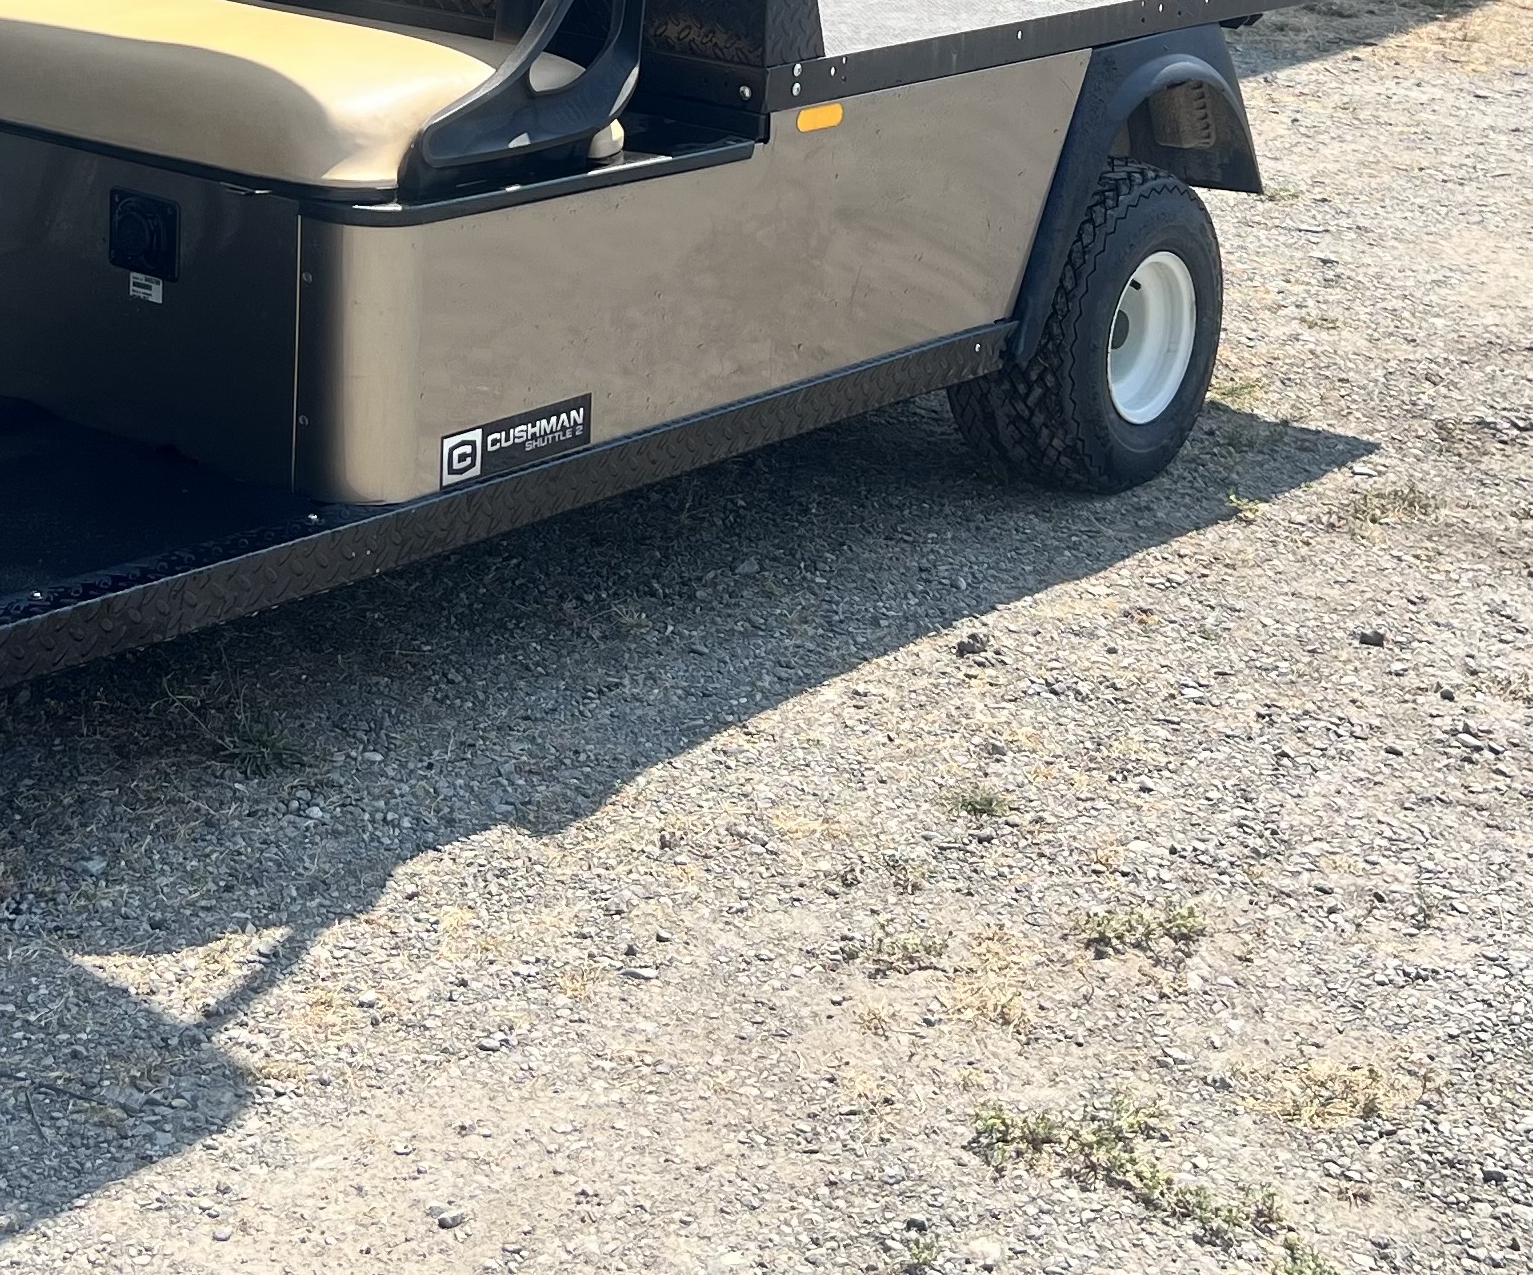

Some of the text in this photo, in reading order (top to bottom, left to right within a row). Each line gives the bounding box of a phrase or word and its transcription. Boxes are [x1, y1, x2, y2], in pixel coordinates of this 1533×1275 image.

[486, 407, 585, 453] CUSHMAN
[524, 425, 584, 452] SHUTTLE 2
